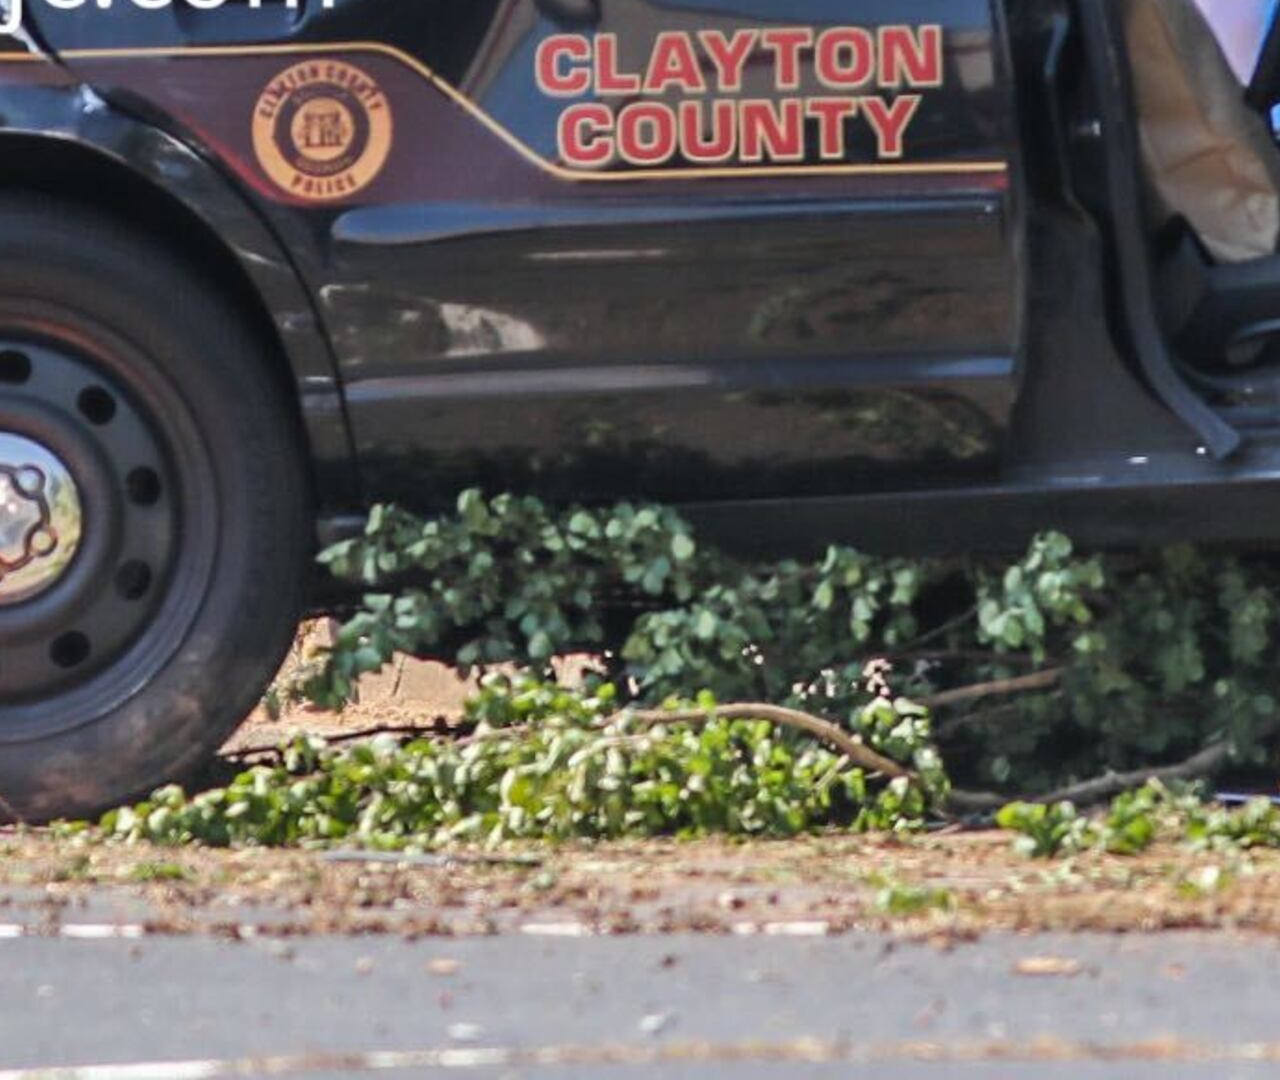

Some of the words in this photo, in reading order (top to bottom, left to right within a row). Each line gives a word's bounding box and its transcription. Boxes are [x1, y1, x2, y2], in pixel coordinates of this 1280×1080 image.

[535, 24, 943, 98] CLAYTON
[556, 94, 922, 168] COUNTY
[291, 173, 357, 195] POLICE
